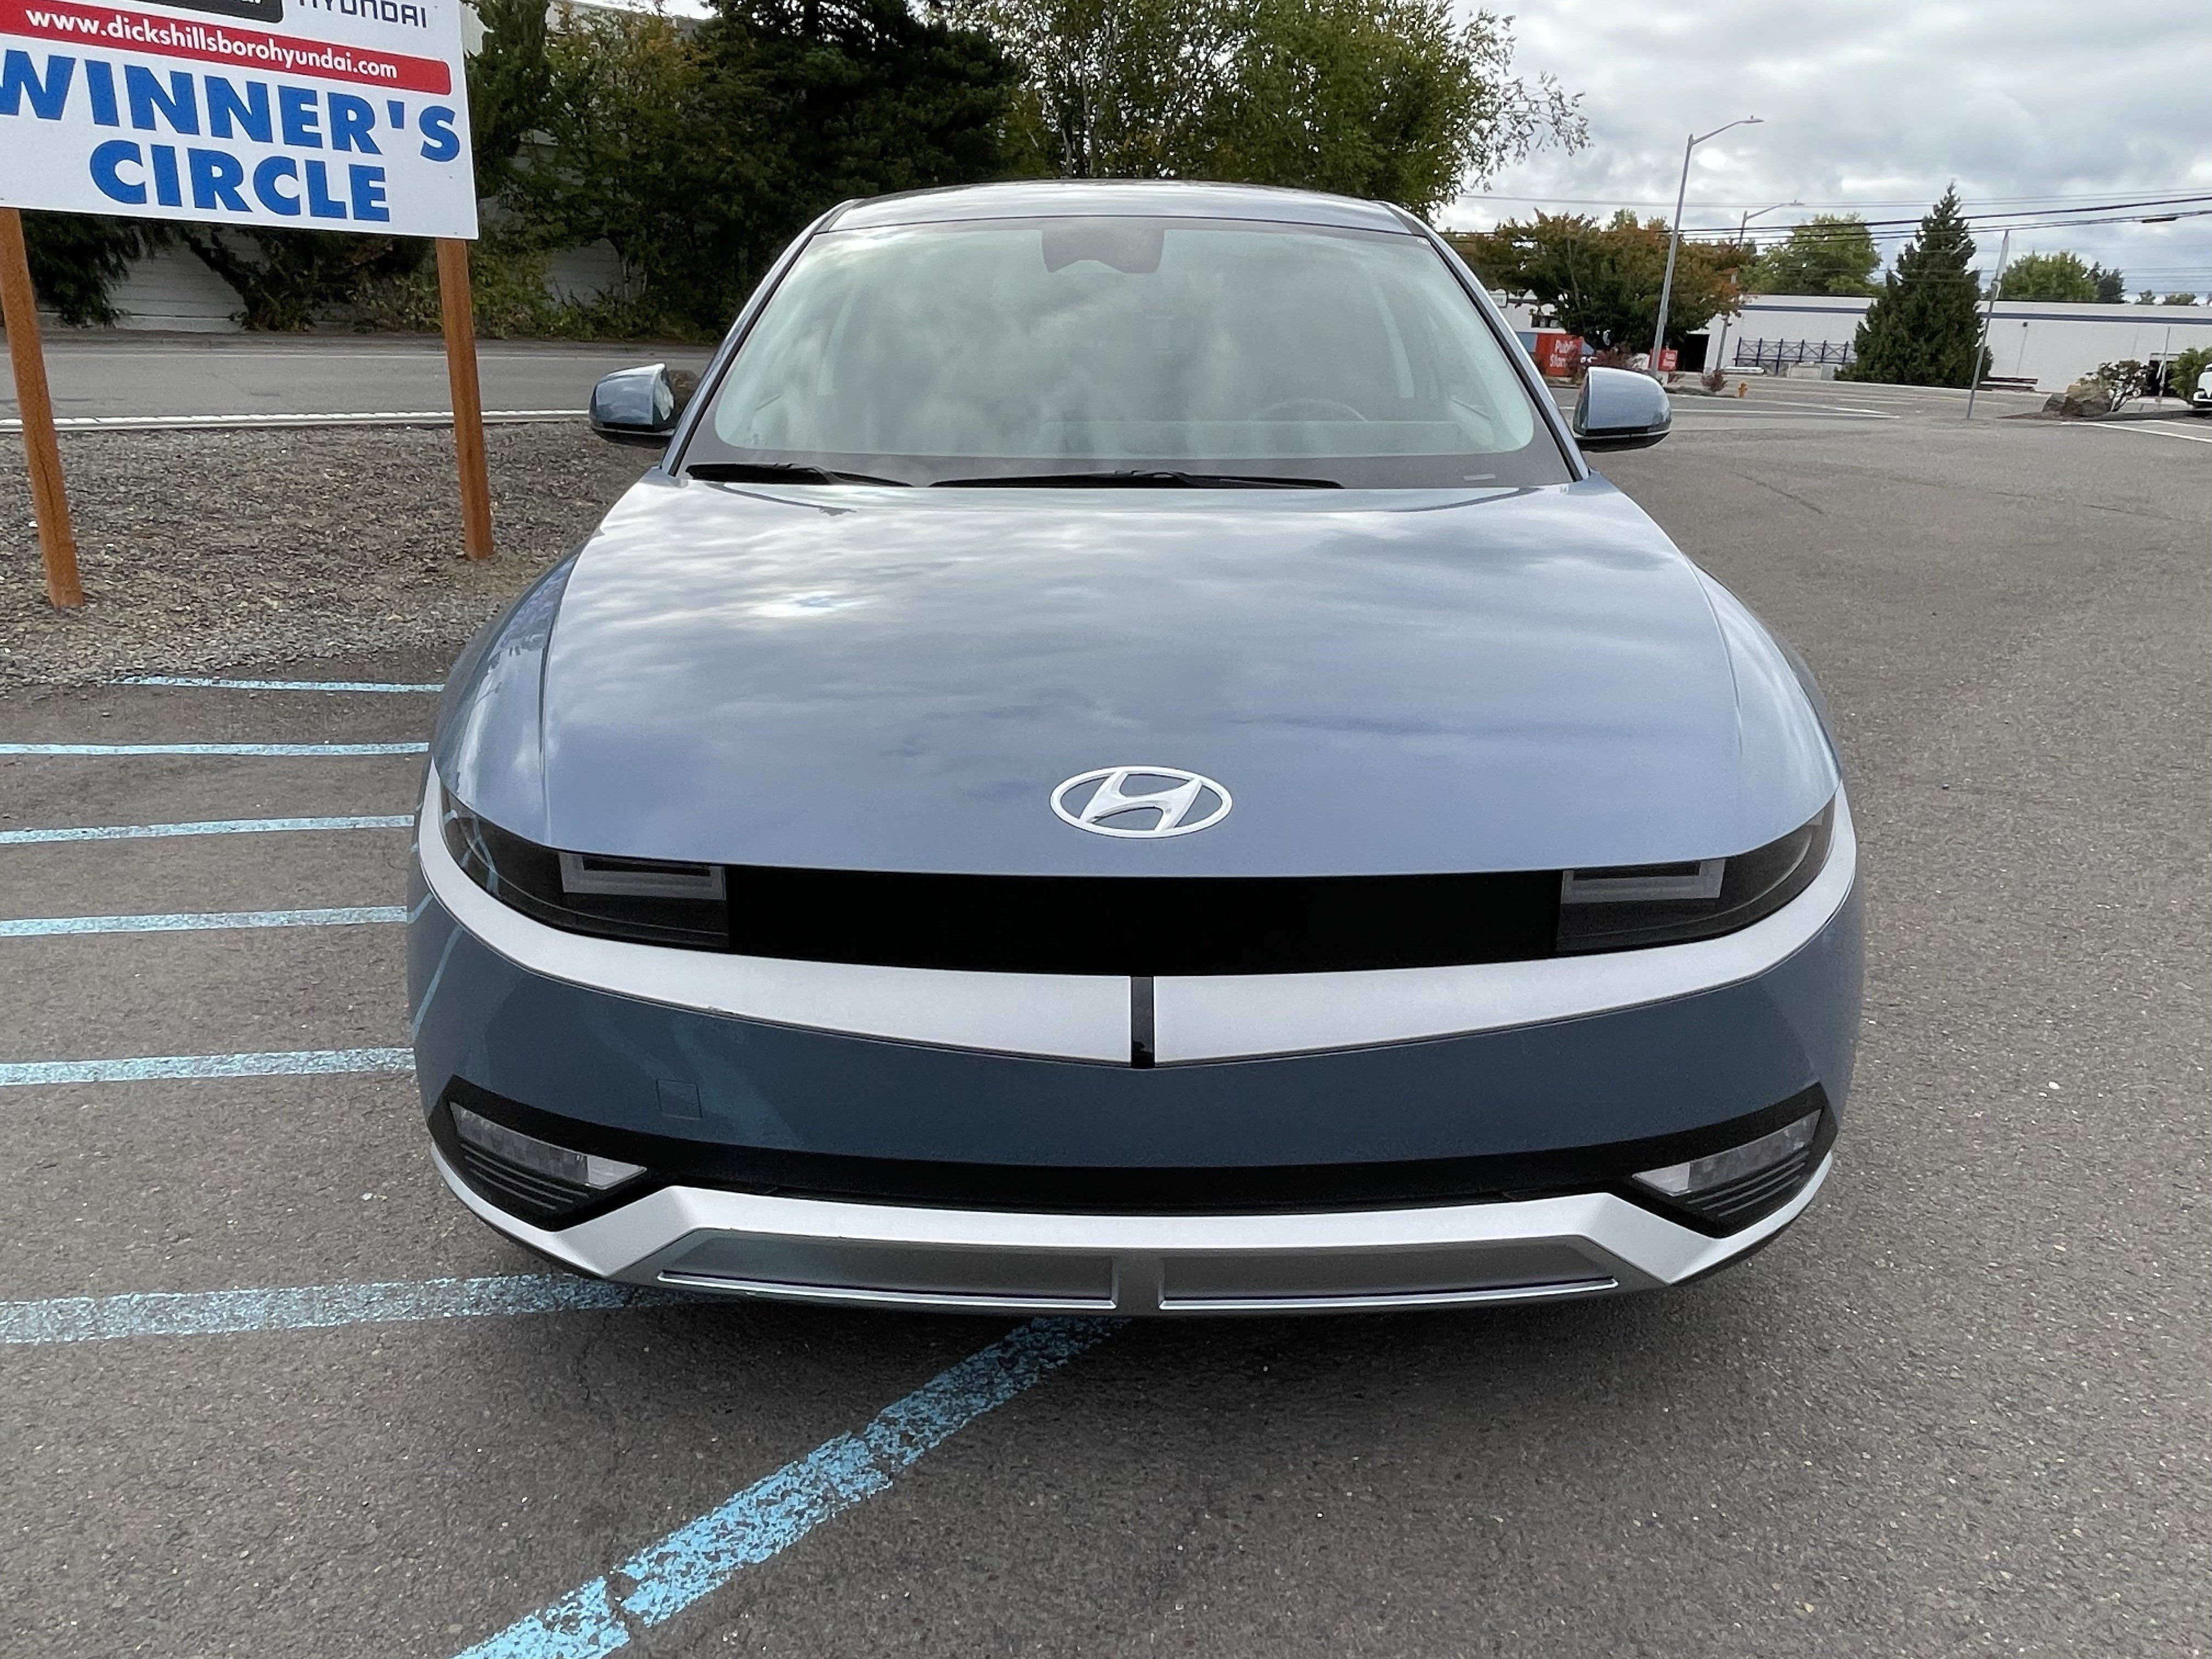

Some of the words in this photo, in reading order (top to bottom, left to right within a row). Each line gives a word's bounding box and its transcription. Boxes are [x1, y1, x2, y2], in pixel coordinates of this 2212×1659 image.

[25, 9, 397, 78] www.dickshillsborohyundai.com
[0, 49, 460, 162] WINNER'S
[90, 140, 390, 222] CIRCLE
